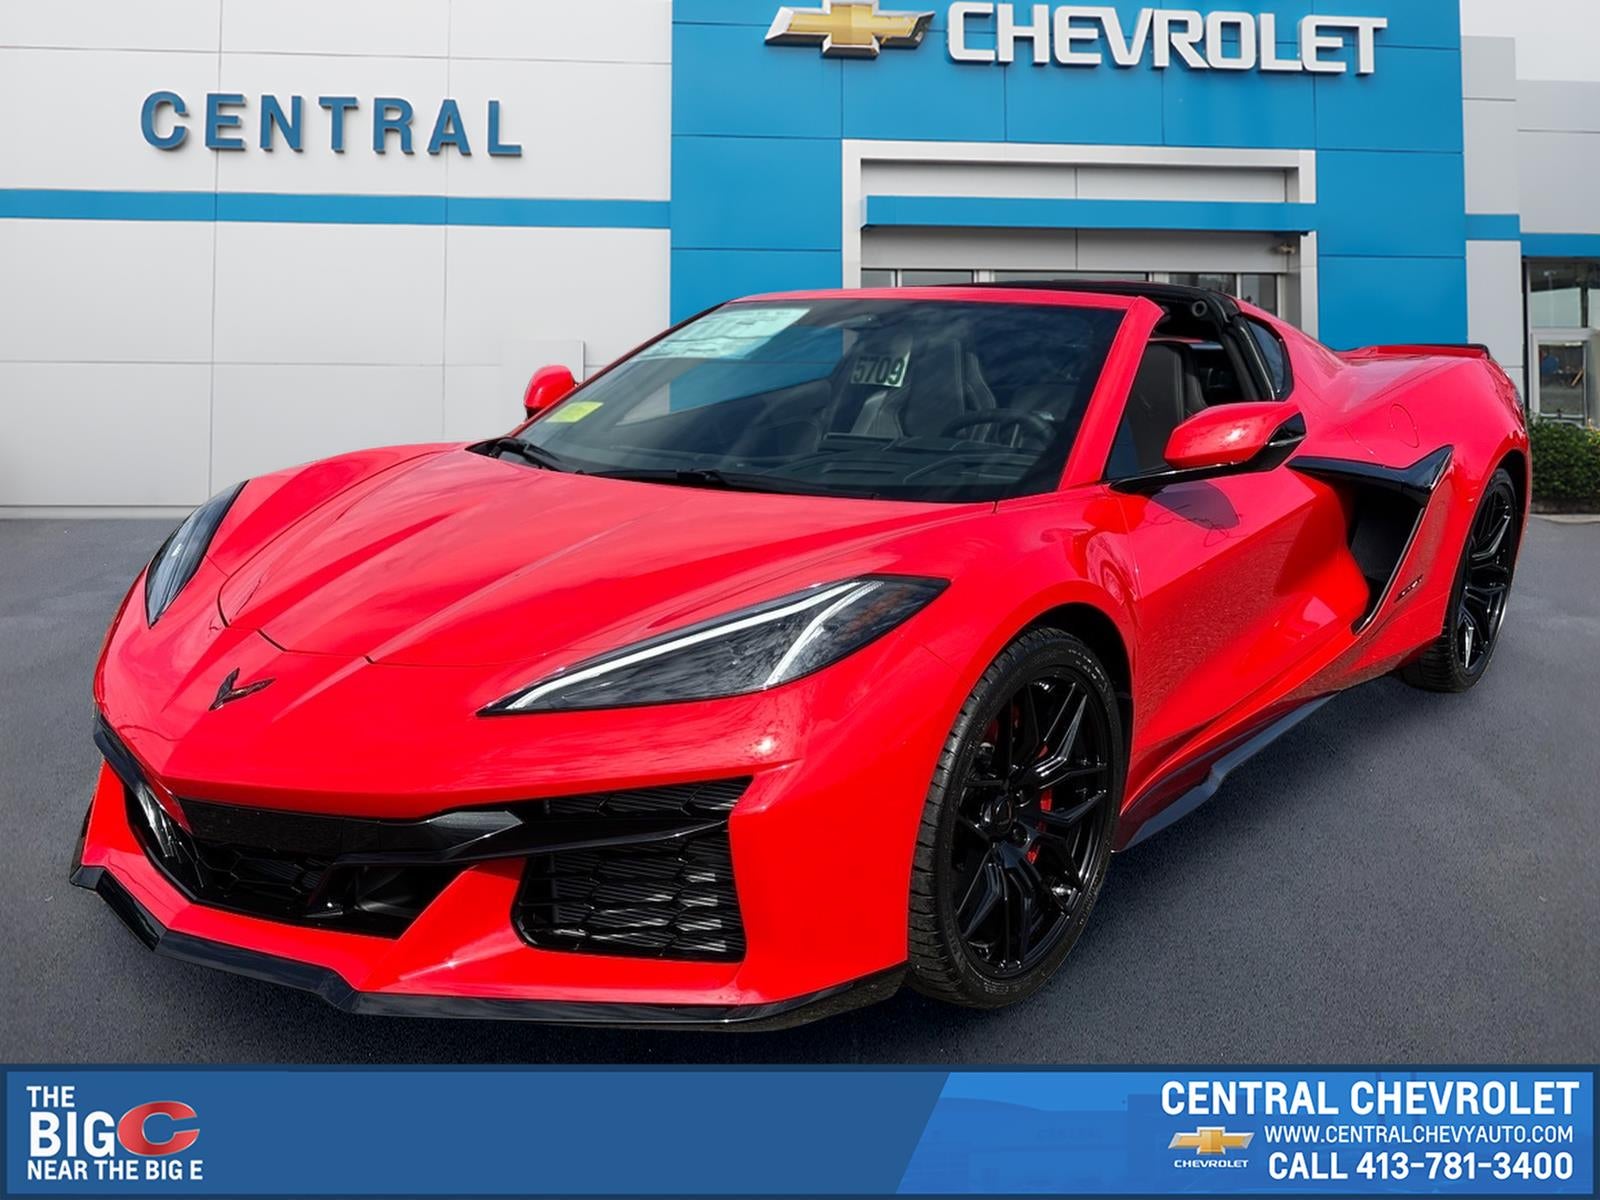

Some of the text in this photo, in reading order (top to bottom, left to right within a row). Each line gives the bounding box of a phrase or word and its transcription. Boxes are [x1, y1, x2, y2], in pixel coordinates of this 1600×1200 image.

[947, 0, 1388, 75] CHEVROLET
[141, 91, 523, 158] CENTRAL
[851, 356, 904, 385] 5709
